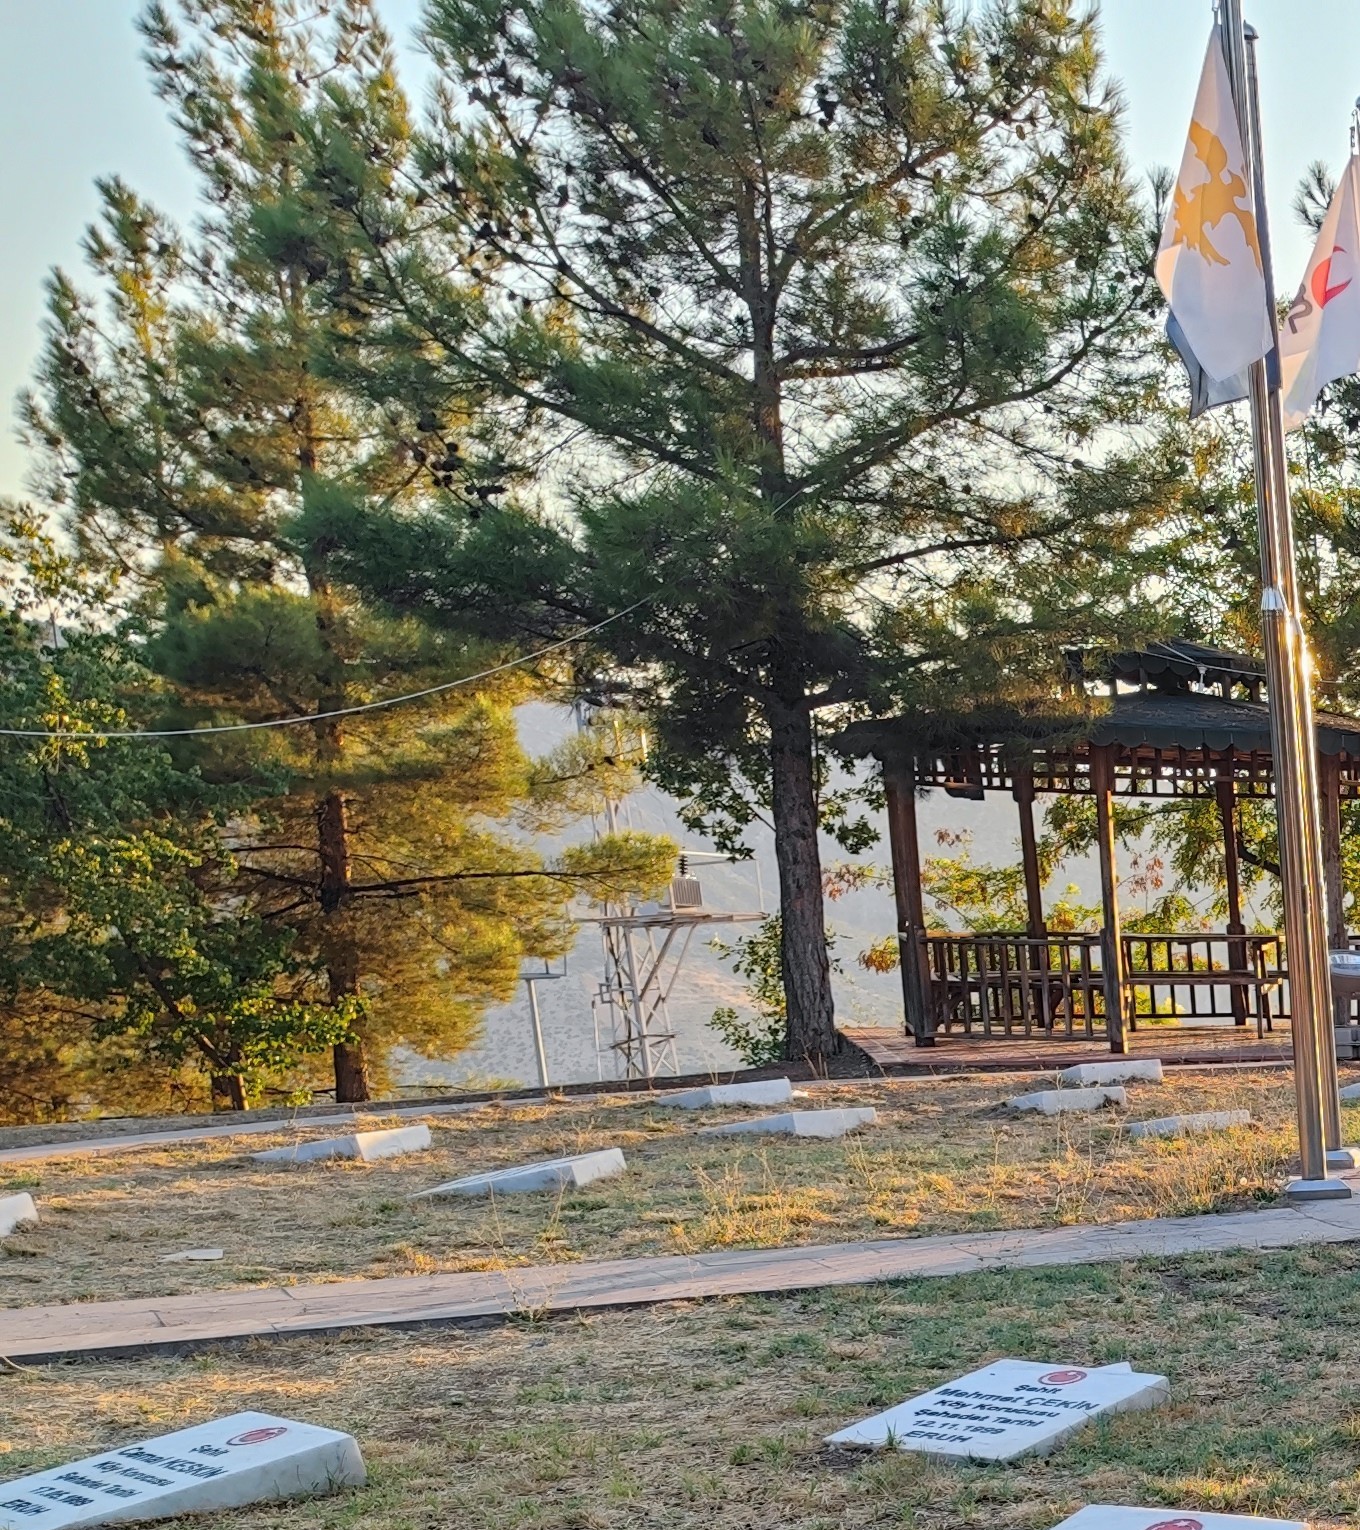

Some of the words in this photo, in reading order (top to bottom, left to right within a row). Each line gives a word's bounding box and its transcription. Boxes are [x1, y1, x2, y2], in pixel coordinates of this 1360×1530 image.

[1014, 1384, 1062, 1395] Şehit
[933, 1399, 970, 1410] Köy
[971, 1403, 1061, 1418] Korucusu
[934, 1388, 1024, 1403] Mehmet
[1023, 1397, 1101, 1411] ÇEKİN
[914, 1408, 991, 1422] Şehadet
[991, 1416, 1044, 1427] Tarihi
[903, 1430, 974, 1443] ERUH
[117, 1447, 174, 1464] Cemal
[92, 1460, 124, 1474] Köy
[0, 1498, 51, 1517] ERUH
